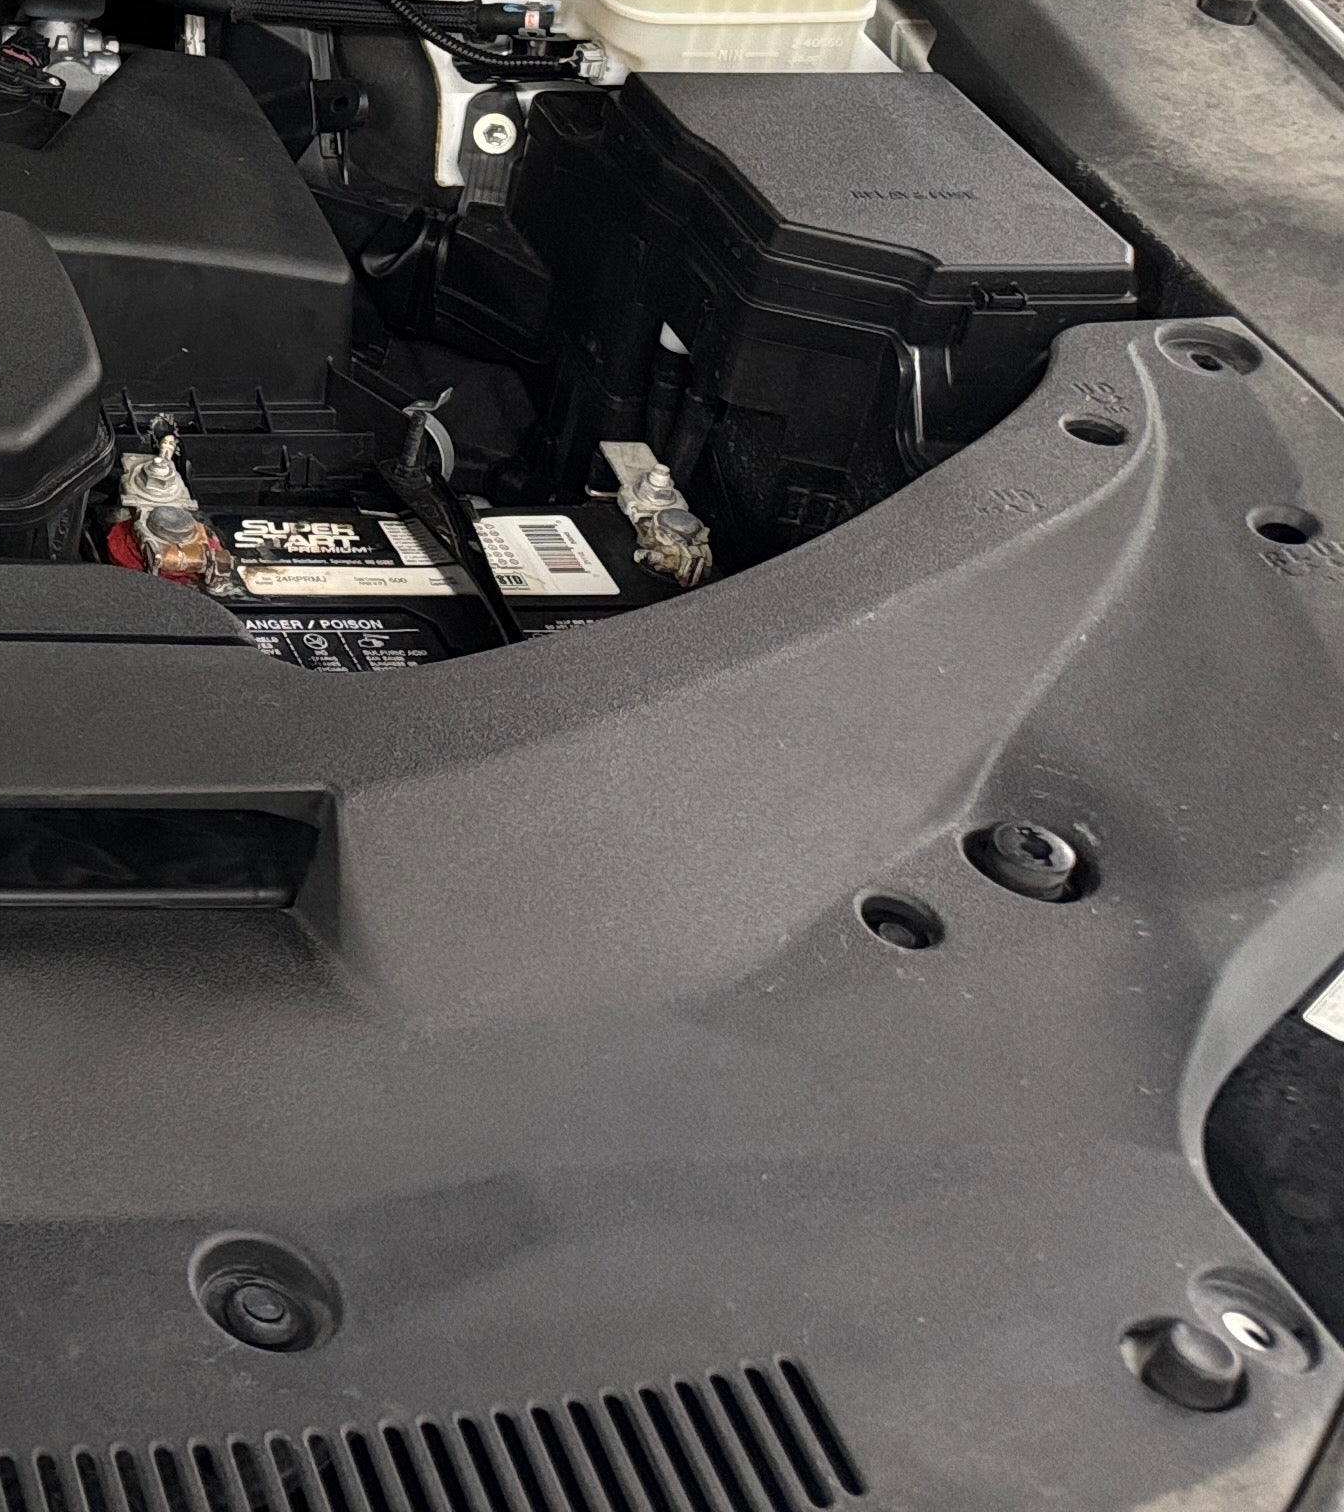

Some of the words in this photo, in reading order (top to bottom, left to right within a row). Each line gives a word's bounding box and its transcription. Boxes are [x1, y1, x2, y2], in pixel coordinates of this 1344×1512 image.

[241, 519, 355, 536] SUPER
[234, 531, 360, 548] START
[245, 619, 304, 630] ANGER
[319, 619, 384, 630] POISON
